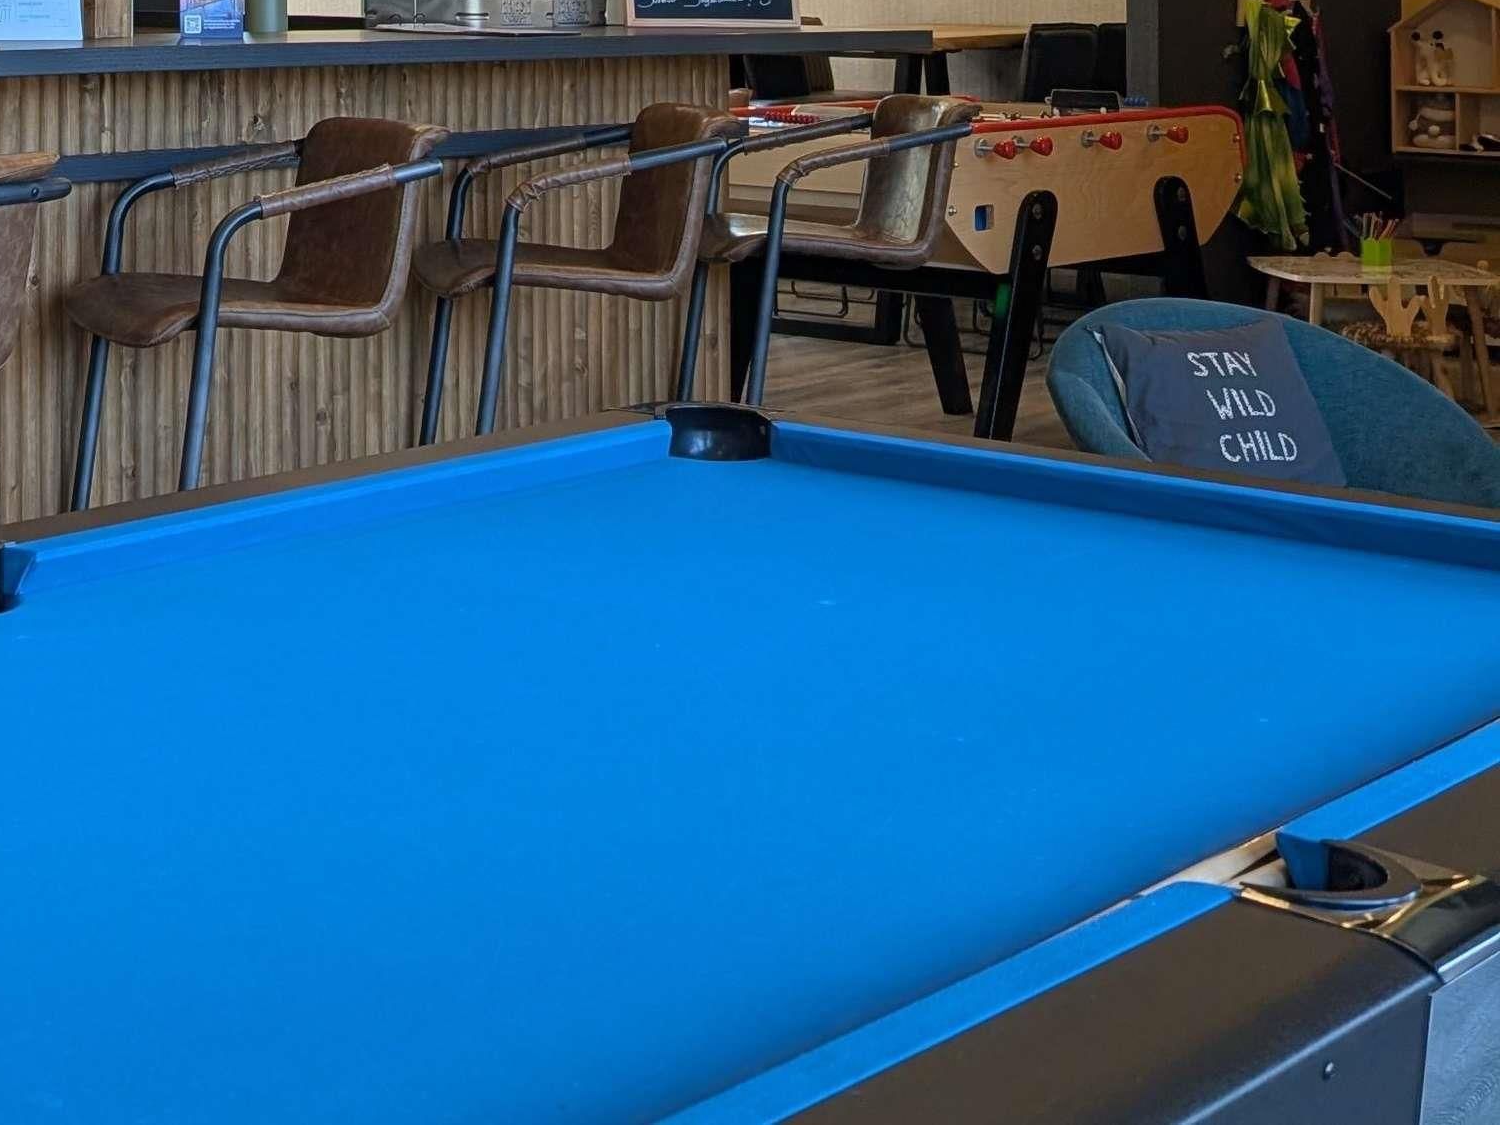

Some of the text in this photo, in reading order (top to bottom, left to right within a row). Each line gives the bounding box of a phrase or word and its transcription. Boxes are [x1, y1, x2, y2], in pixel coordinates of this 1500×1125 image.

[1186, 350, 1258, 377] STAY
[1205, 387, 1277, 420] WILD
[1218, 429, 1299, 463] CHILD
